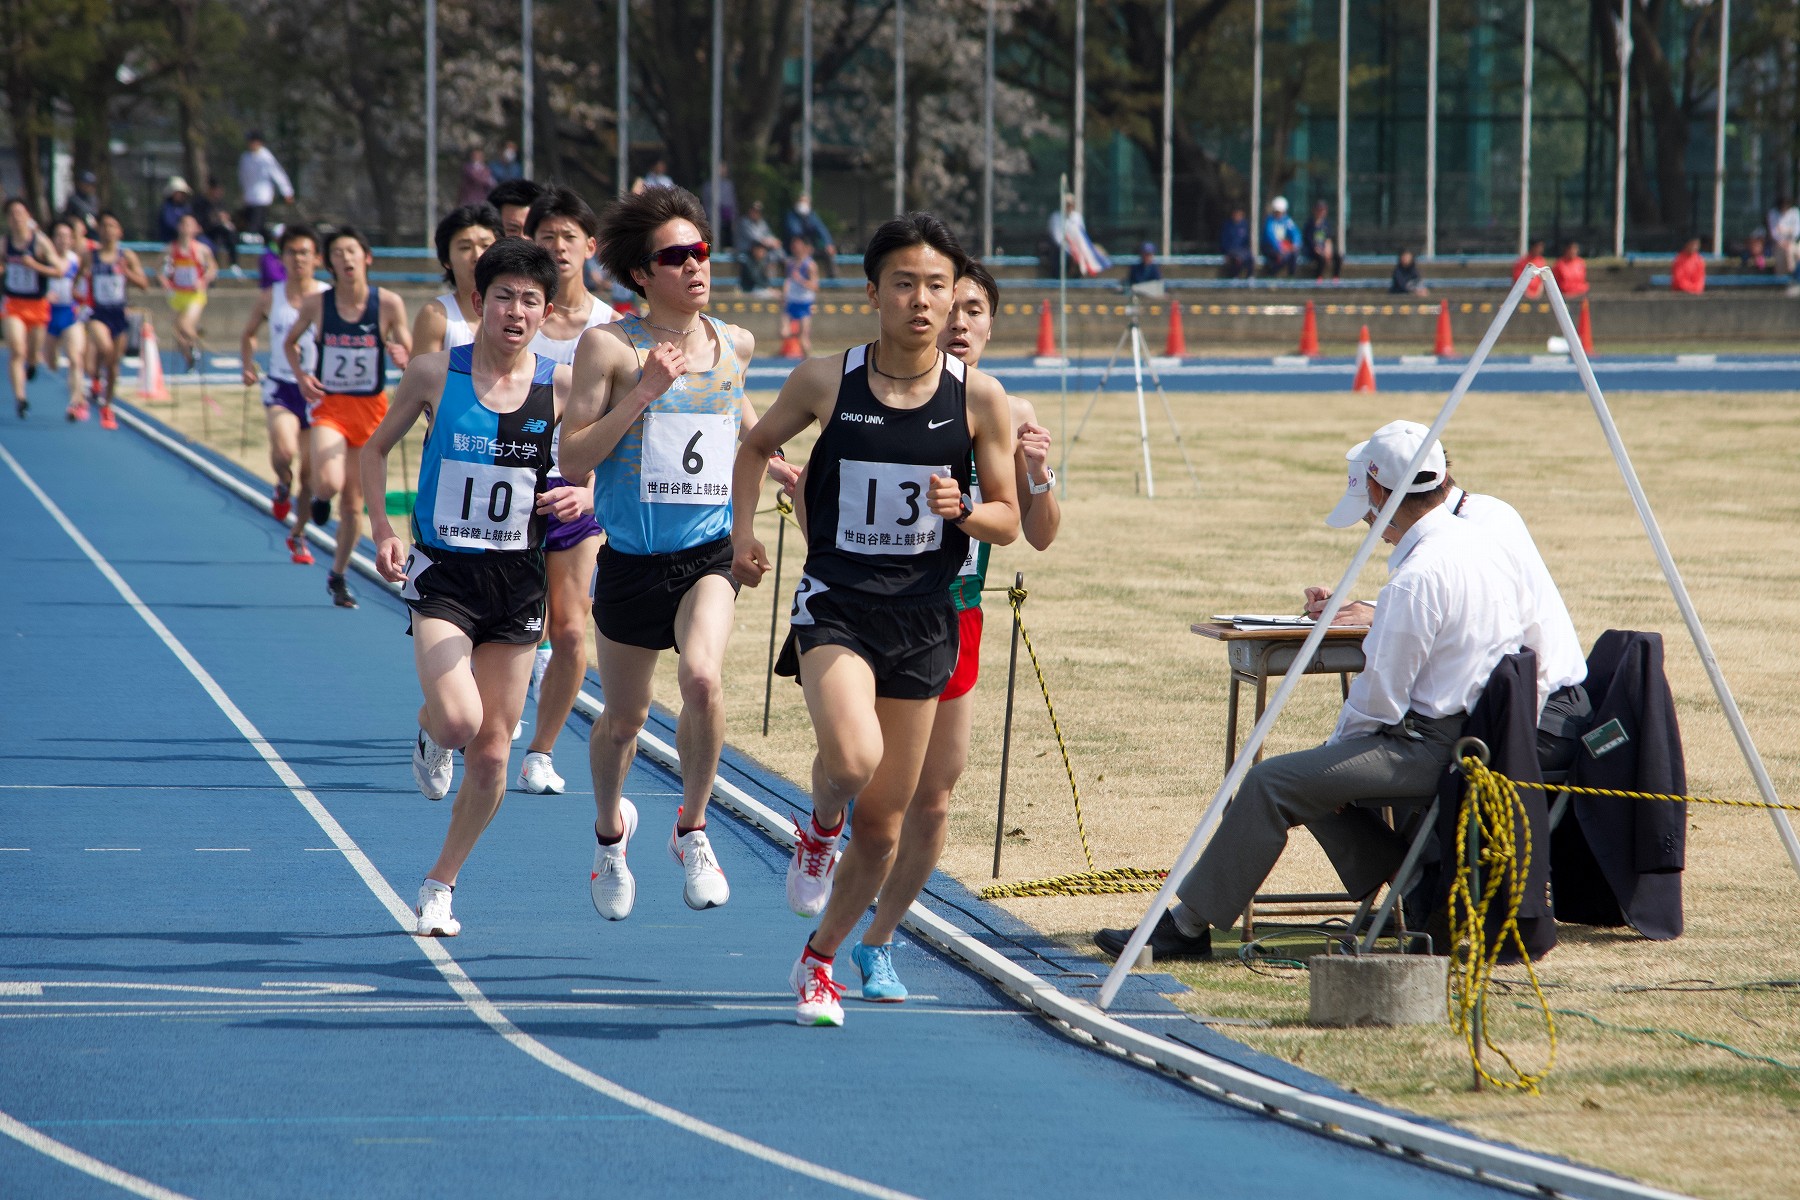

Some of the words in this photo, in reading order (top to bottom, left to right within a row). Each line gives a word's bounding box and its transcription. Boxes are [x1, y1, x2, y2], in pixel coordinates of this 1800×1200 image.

[335, 355, 367, 378] 25
[840, 412, 863, 423] CHUO
[864, 416, 884, 425] UNIV.
[453, 433, 538, 460] 駿河台大学
[682, 430, 704, 475] 6
[461, 477, 513, 523] 10
[647, 481, 729, 496] 世田谷陸上競技会
[866, 478, 921, 526] 13
[438, 524, 522, 542] 世田谷陸上競技会
[844, 529, 936, 547] 世田谷陸上競技会
